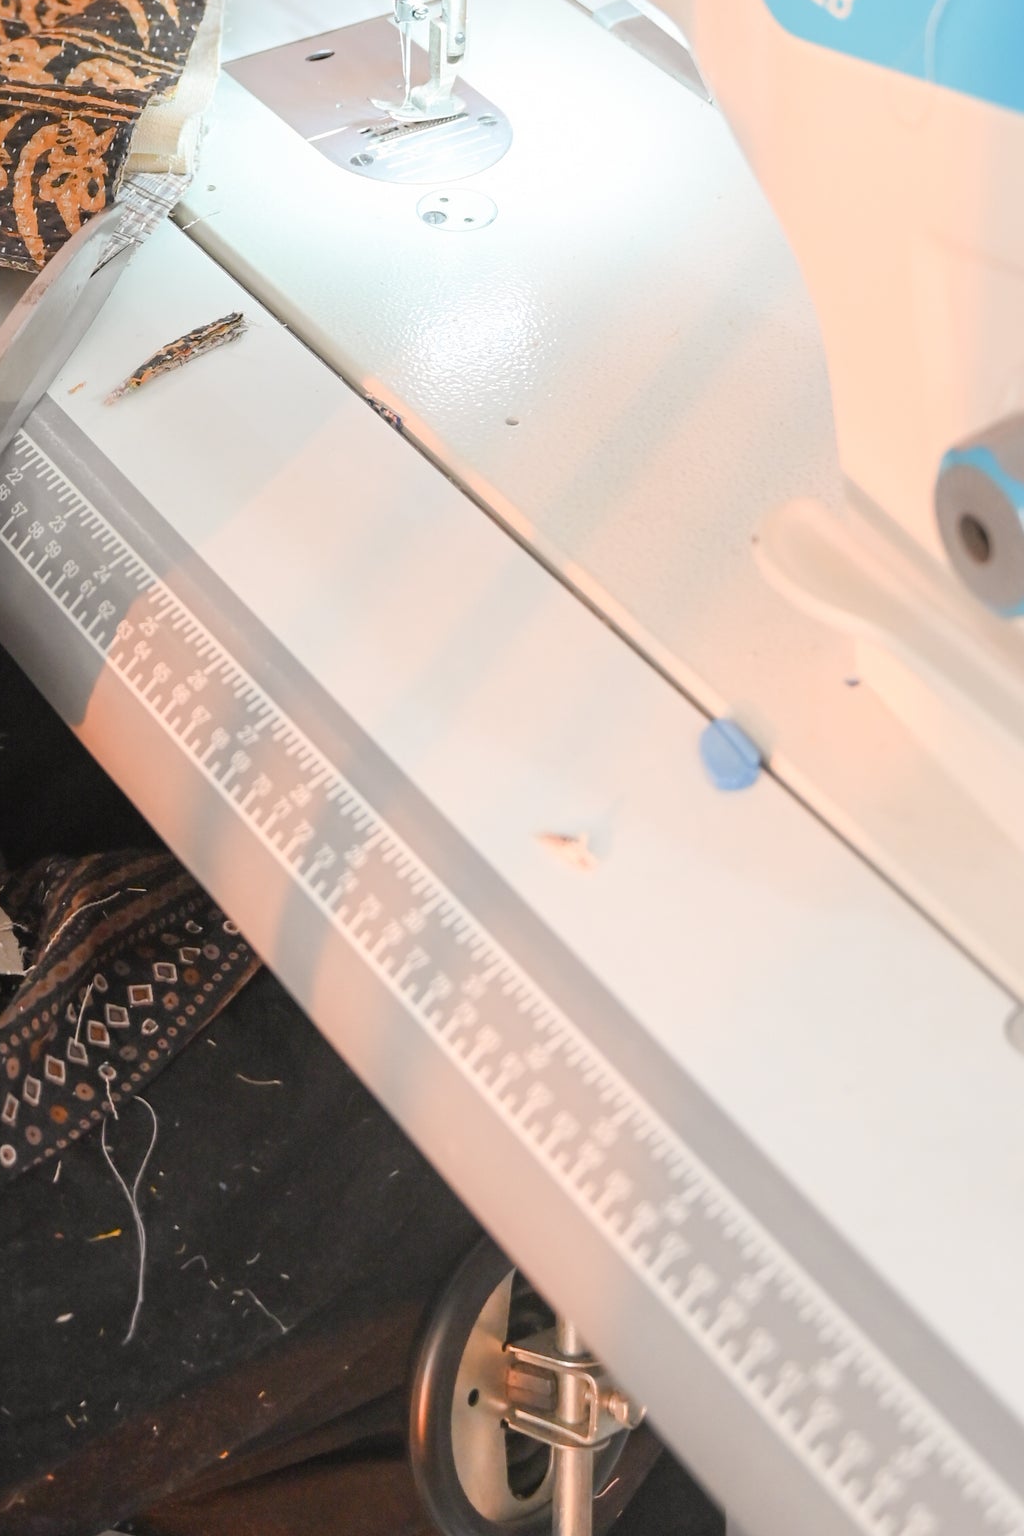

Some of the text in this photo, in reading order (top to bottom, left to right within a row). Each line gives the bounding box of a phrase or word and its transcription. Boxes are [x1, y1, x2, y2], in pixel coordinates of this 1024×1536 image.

[5, 467, 24, 486] 22
[48, 515, 67, 533] 23
[92, 565, 112, 584] 24
[138, 615, 159, 637] 25
[236, 724, 260, 746] 27
[11, 501, 28, 518] 57
[27, 520, 45, 539] 58
[44, 540, 62, 558] 59
[62, 559, 80, 578] 60
[80, 579, 97, 598] 61
[98, 599, 116, 620] 62
[134, 640, 153, 661] 64
